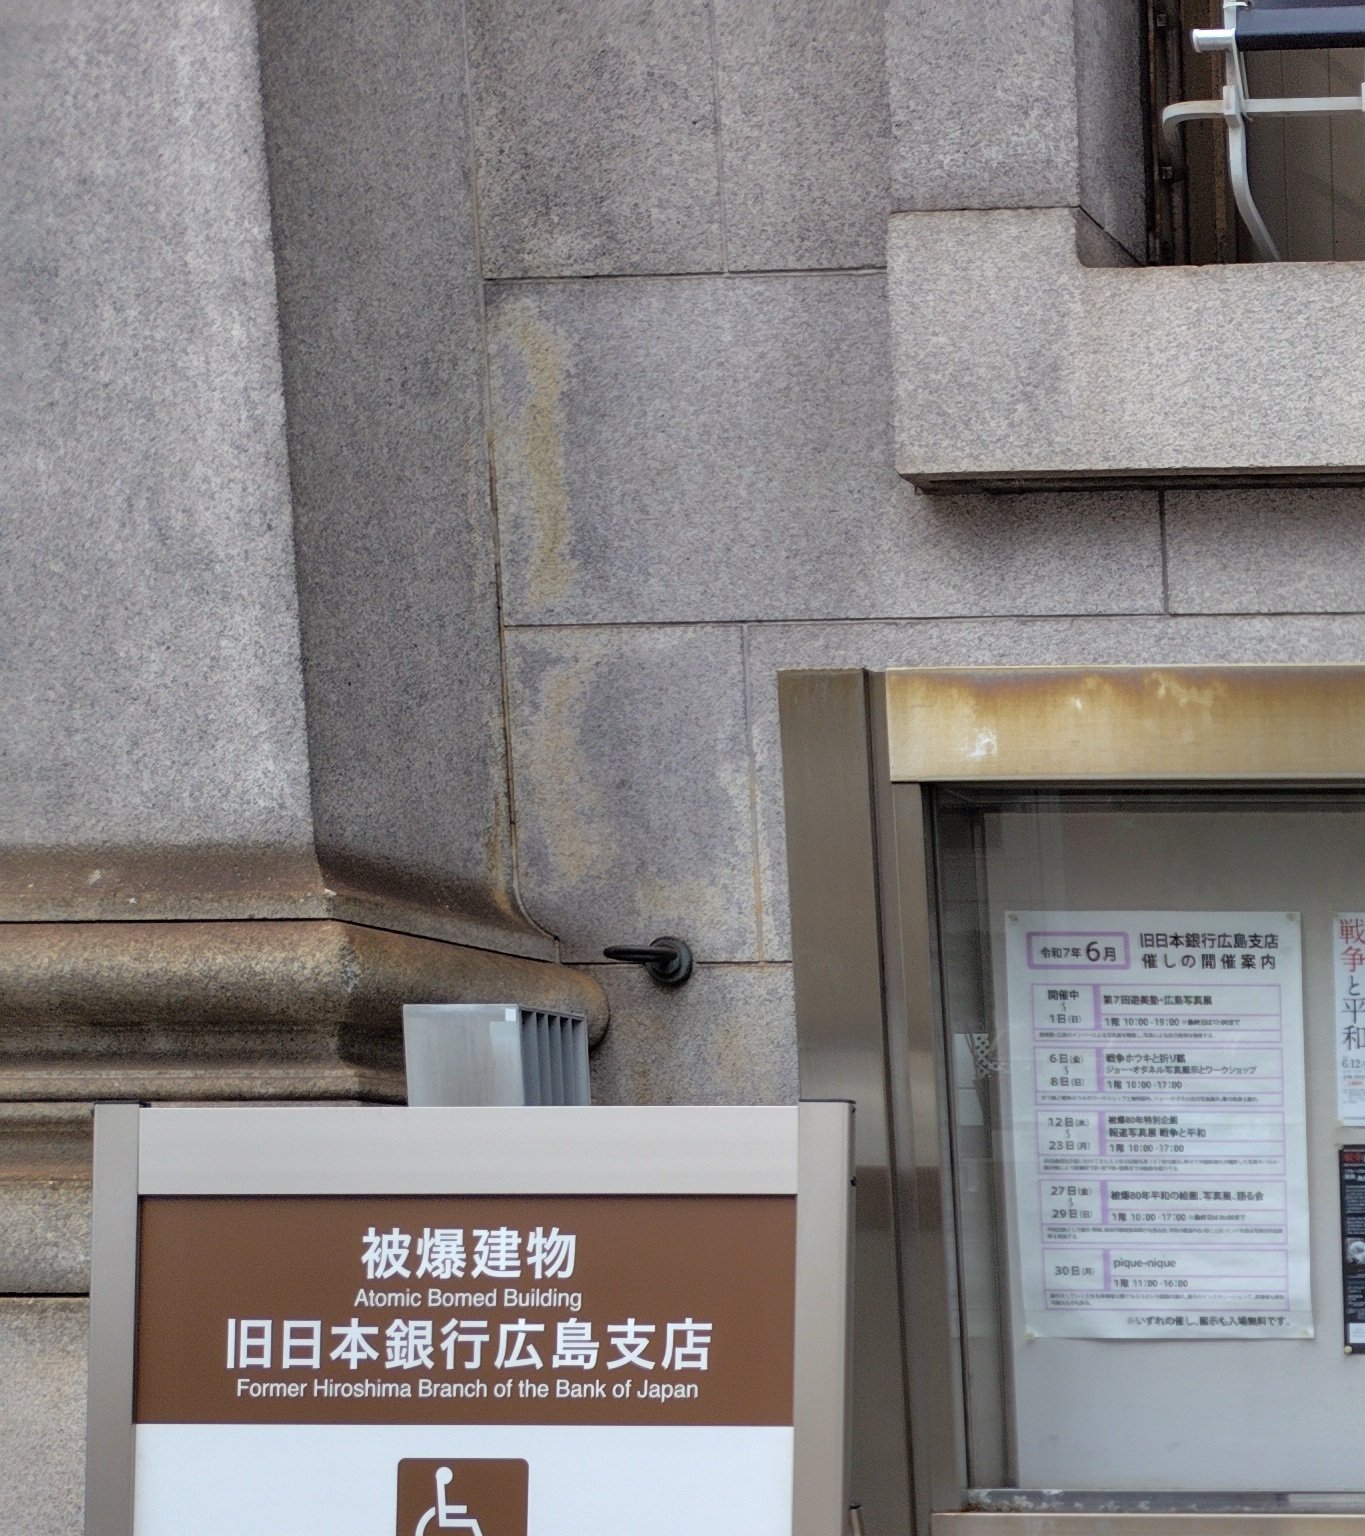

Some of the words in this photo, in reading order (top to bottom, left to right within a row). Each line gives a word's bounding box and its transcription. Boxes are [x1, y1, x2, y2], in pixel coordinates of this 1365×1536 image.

[1040, 940, 1118, 963] 令和7年6月
[1139, 932, 1279, 950] 旧日本銀行広島支店
[1141, 953, 1277, 970] 催しの開催案内
[360, 1226, 577, 1281] 被爆建物
[1113, 1257, 1177, 1269] pique-nique
[353, 1288, 422, 1308] Atomic
[427, 1288, 497, 1308] Bomed
[502, 1288, 583, 1312] Building
[225, 1317, 713, 1372] 旧日本銀行広島支店
[236, 1378, 307, 1399] Former
[313, 1378, 412, 1399] Hiroshima
[418, 1378, 489, 1399] Branch
[494, 1378, 514, 1399] of
[517, 1378, 550, 1399] the
[556, 1379, 607, 1400] Bank
[612, 1379, 632, 1400] of
[636, 1379, 699, 1404] Japan
